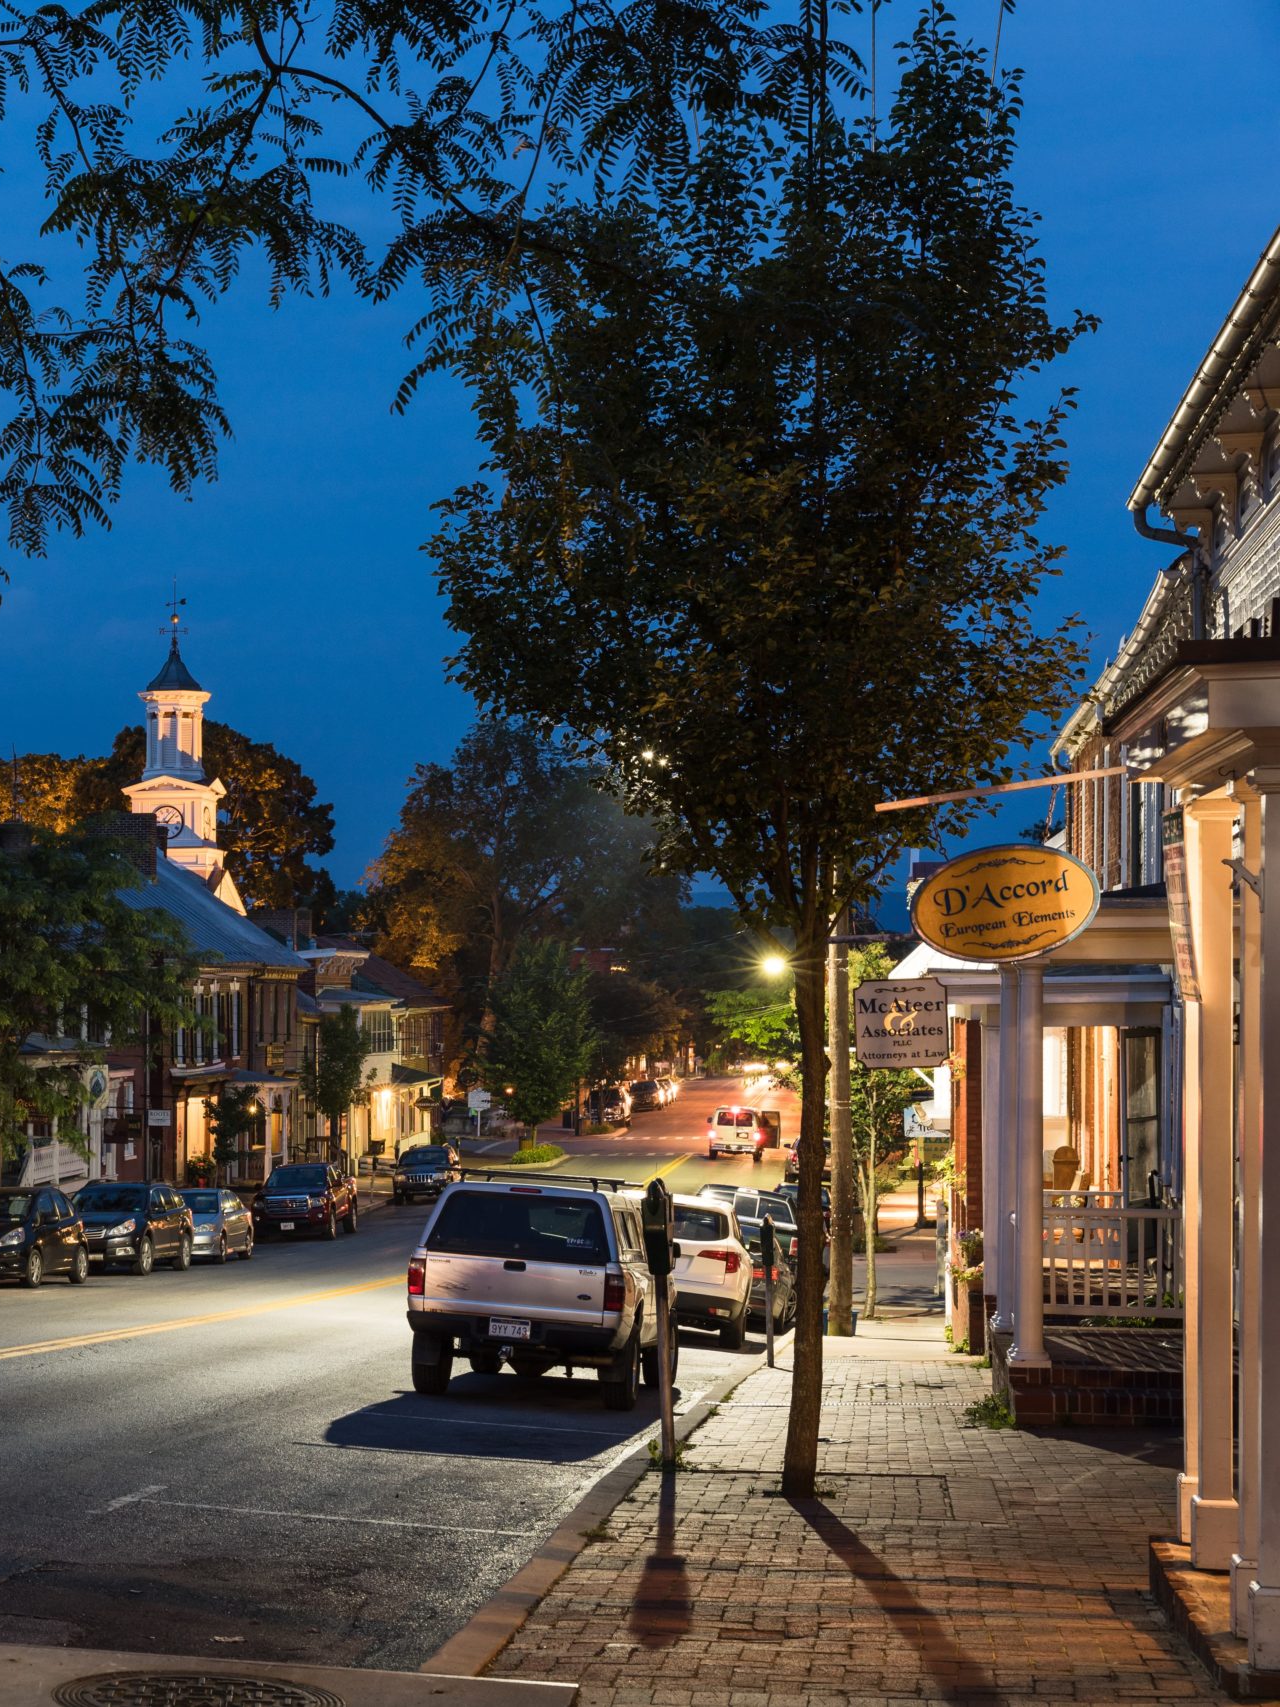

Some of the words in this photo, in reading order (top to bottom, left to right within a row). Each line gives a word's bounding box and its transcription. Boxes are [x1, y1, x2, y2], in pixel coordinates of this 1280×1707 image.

[933, 869, 1069, 916] D'Accord
[940, 919, 1007, 938] European
[1012, 909, 1075, 927] Elements
[857, 997, 944, 1014] McAteer
[861, 1024, 944, 1038] Associates
[861, 1051, 907, 1061] Attorneys
[911, 1050, 921, 1058] at
[925, 1049, 946, 1058] Law
[491, 1324, 508, 1335] 9YY
